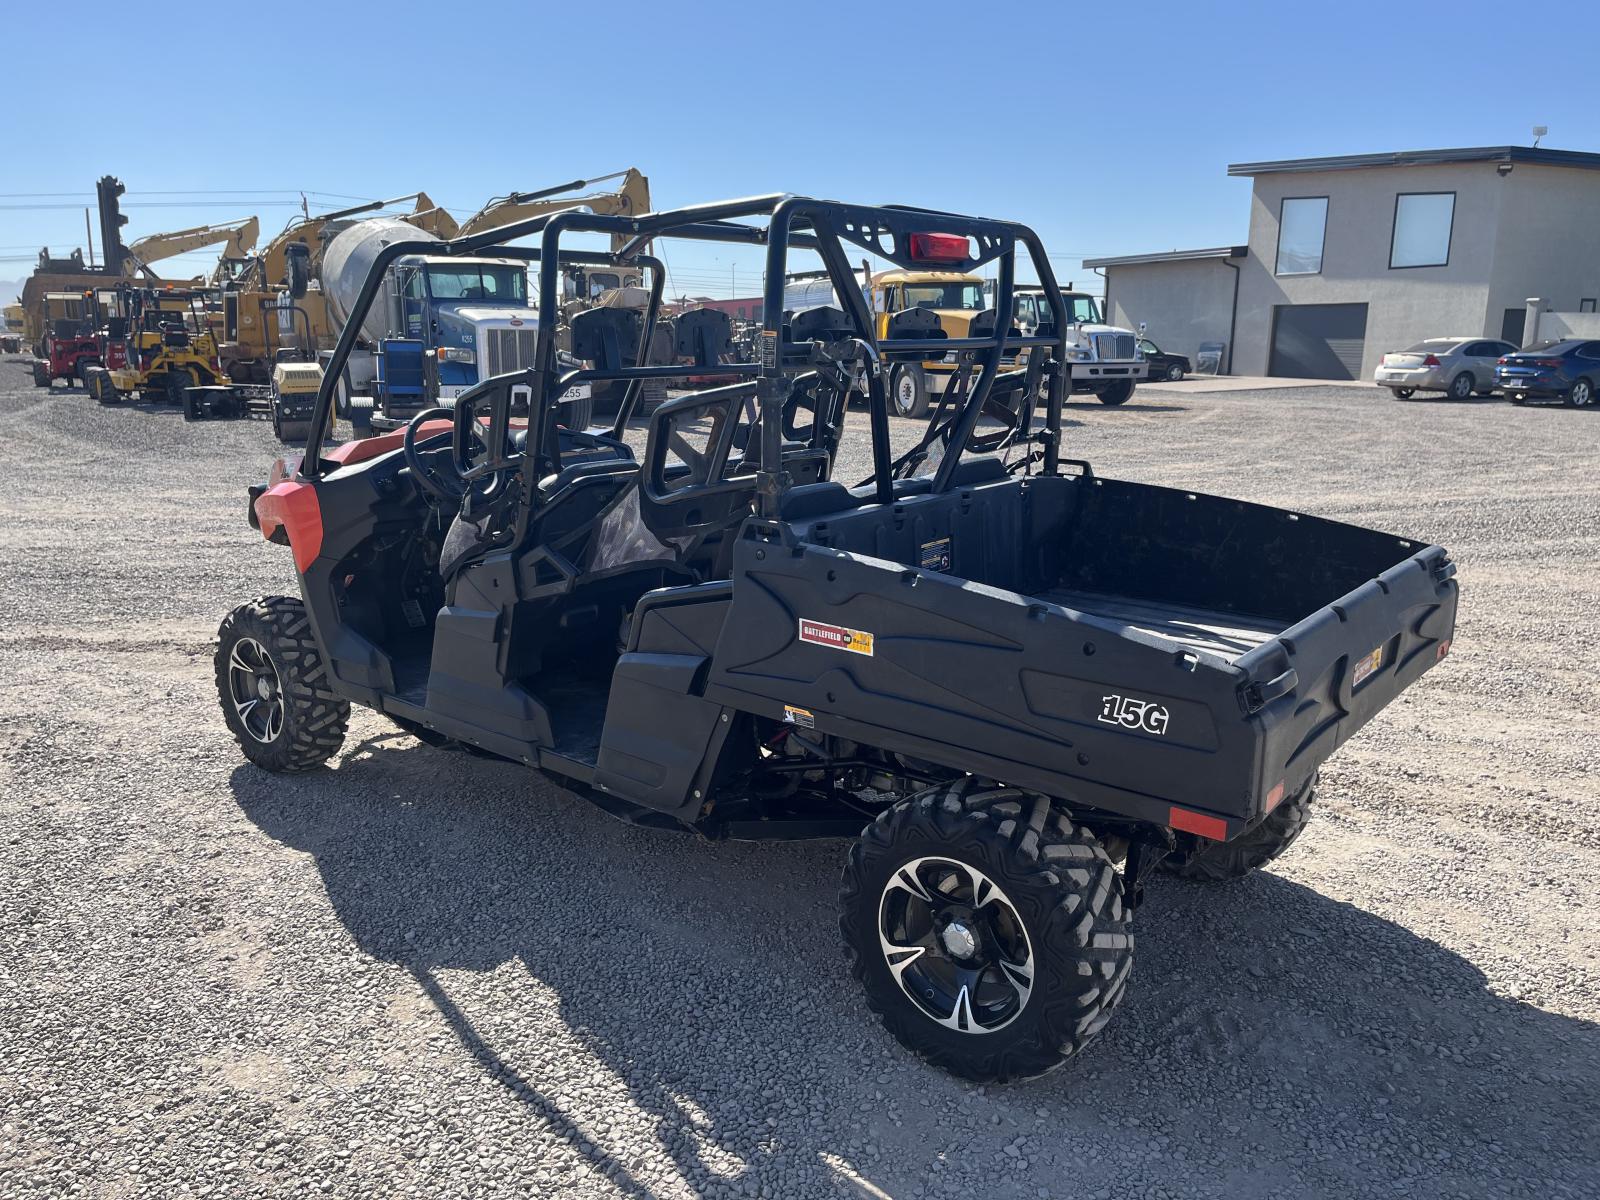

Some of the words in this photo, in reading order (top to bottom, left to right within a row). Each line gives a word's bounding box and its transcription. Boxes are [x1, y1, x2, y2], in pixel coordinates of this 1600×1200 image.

[561, 388, 581, 398] 255
[804, 626, 841, 642] BATTLEFIELD
[1097, 694, 1170, 736] 15G
